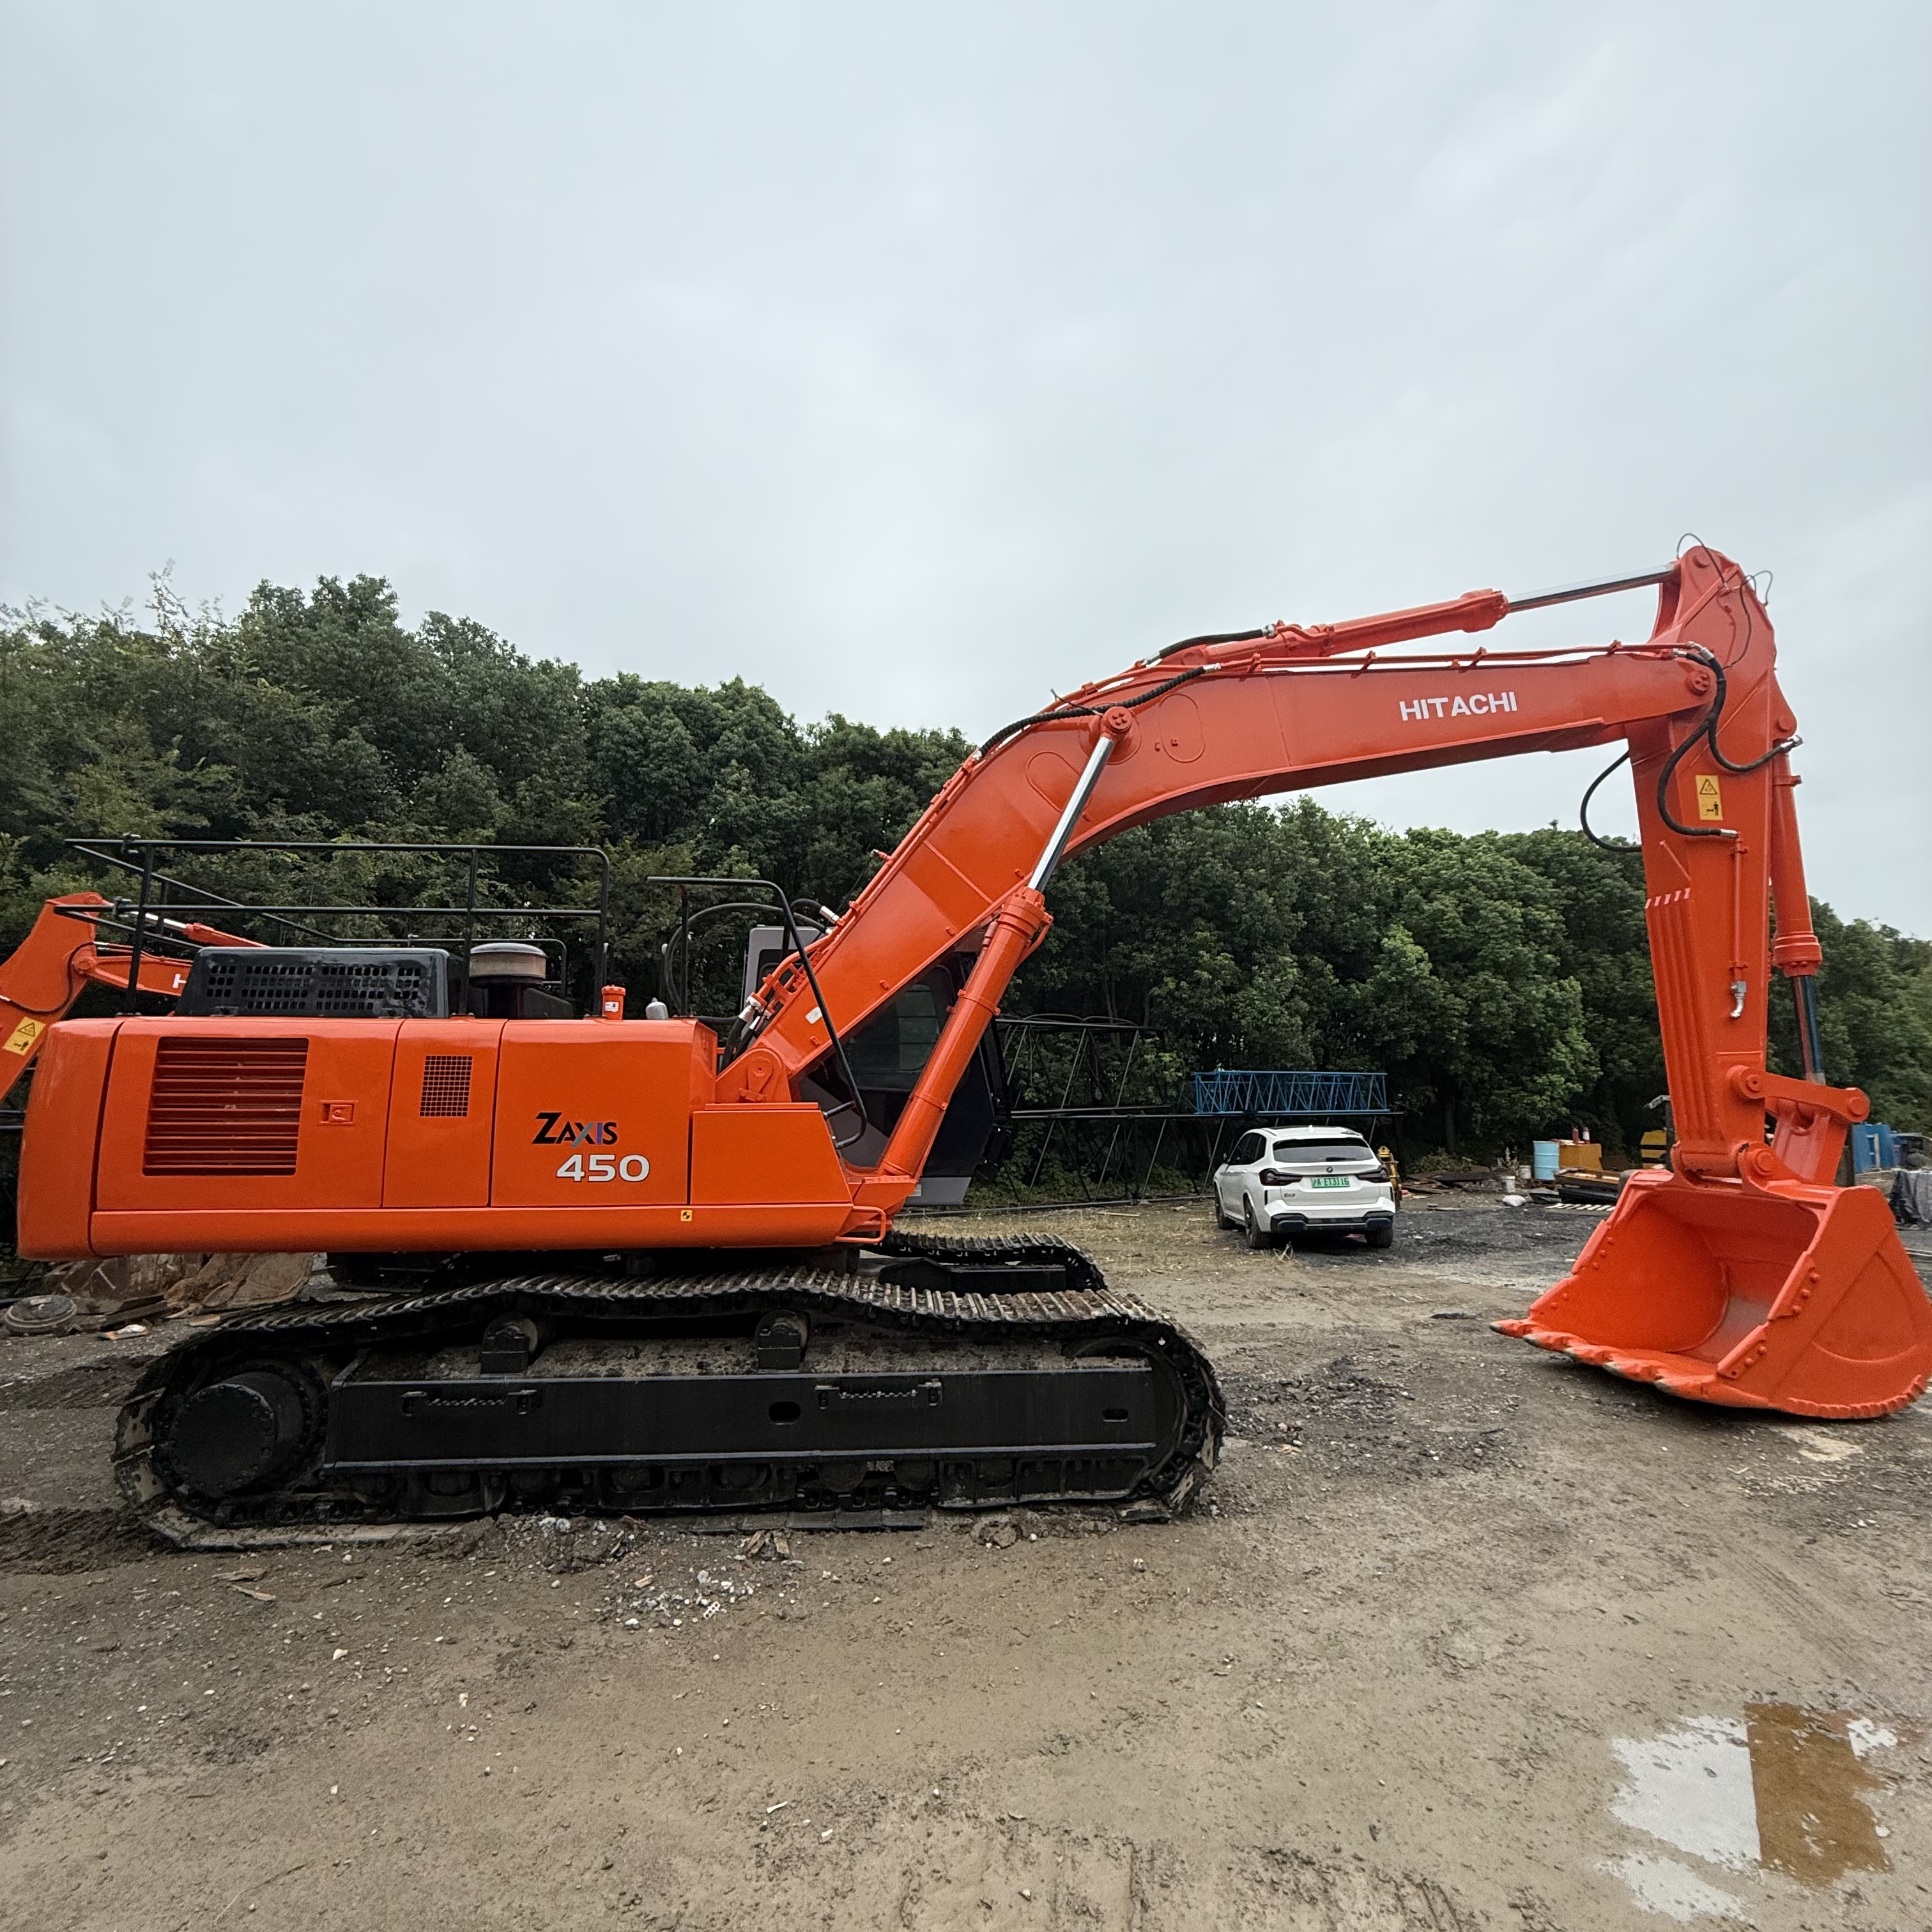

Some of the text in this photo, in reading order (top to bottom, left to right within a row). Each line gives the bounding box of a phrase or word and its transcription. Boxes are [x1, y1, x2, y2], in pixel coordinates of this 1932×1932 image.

[1399, 691, 1517, 721] HITACHI
[532, 1112, 618, 1148] ZAXIS
[556, 1154, 650, 1183] 450
